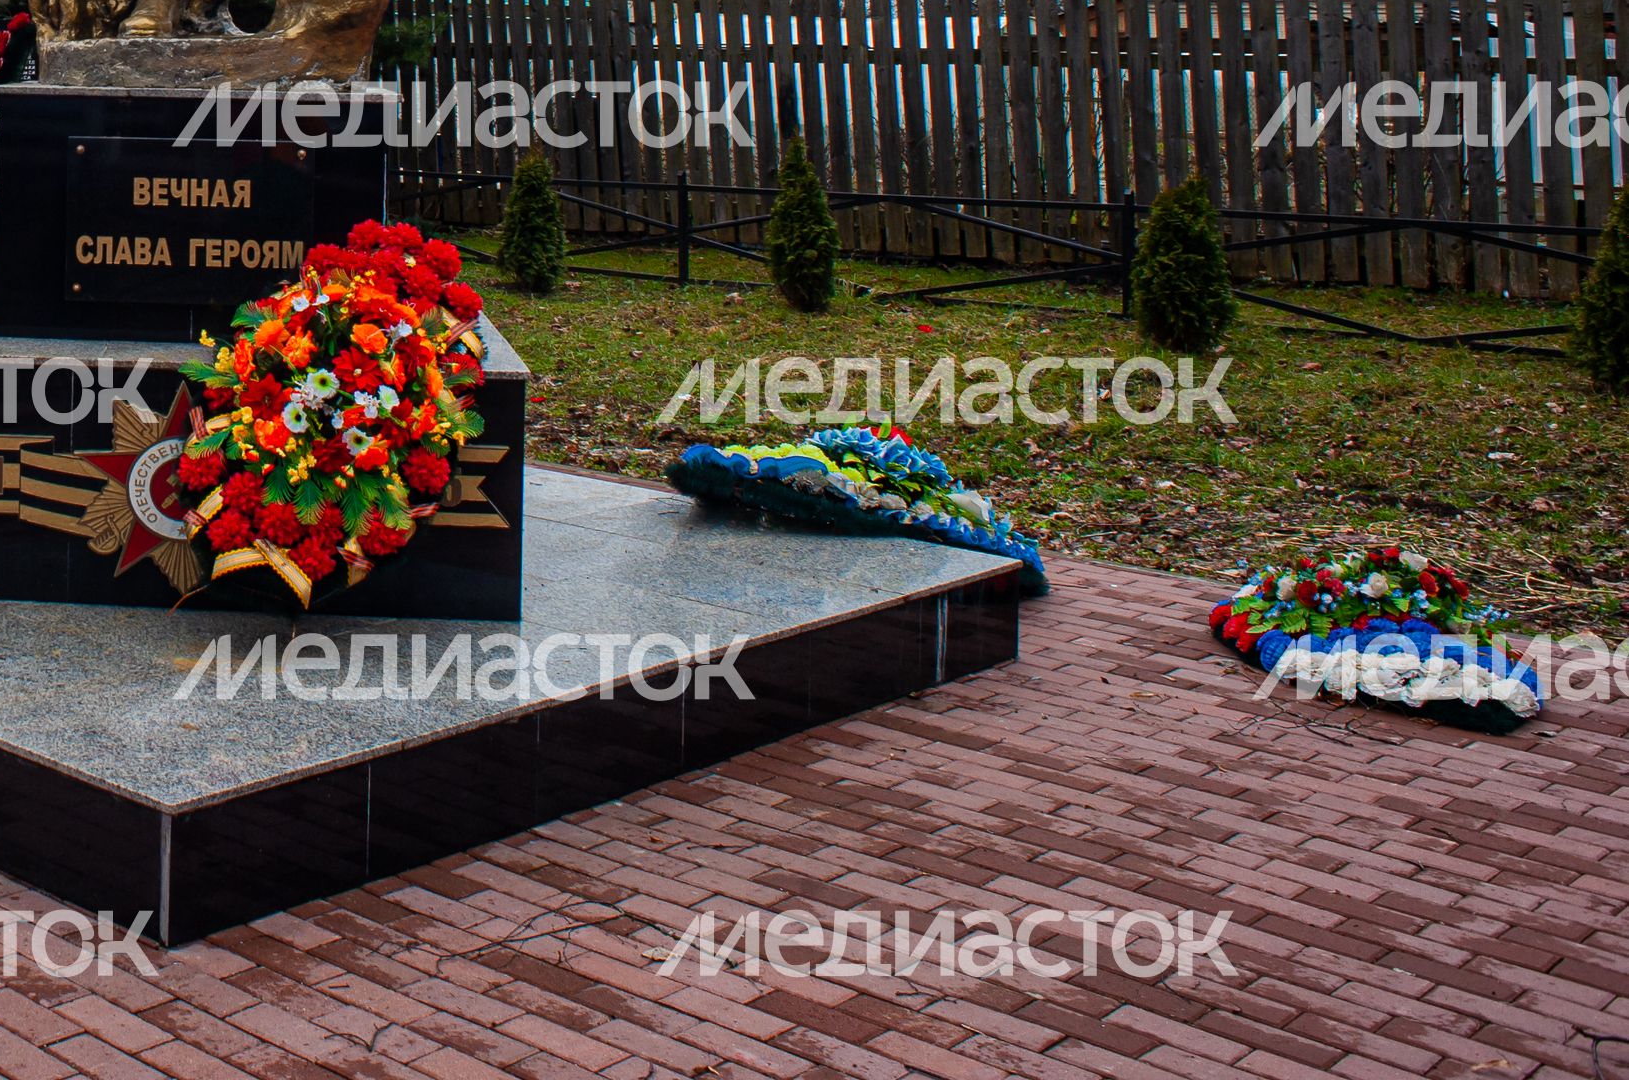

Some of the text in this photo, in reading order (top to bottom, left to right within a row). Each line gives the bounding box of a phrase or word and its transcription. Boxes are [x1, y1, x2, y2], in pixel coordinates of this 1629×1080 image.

[133, 177, 251, 207] ВЕЧНАЯ
[75, 235, 304, 269] СЛАВА ГЕРОЯМ
[135, 442, 184, 524] ОТЕЧЕСТВЕН
